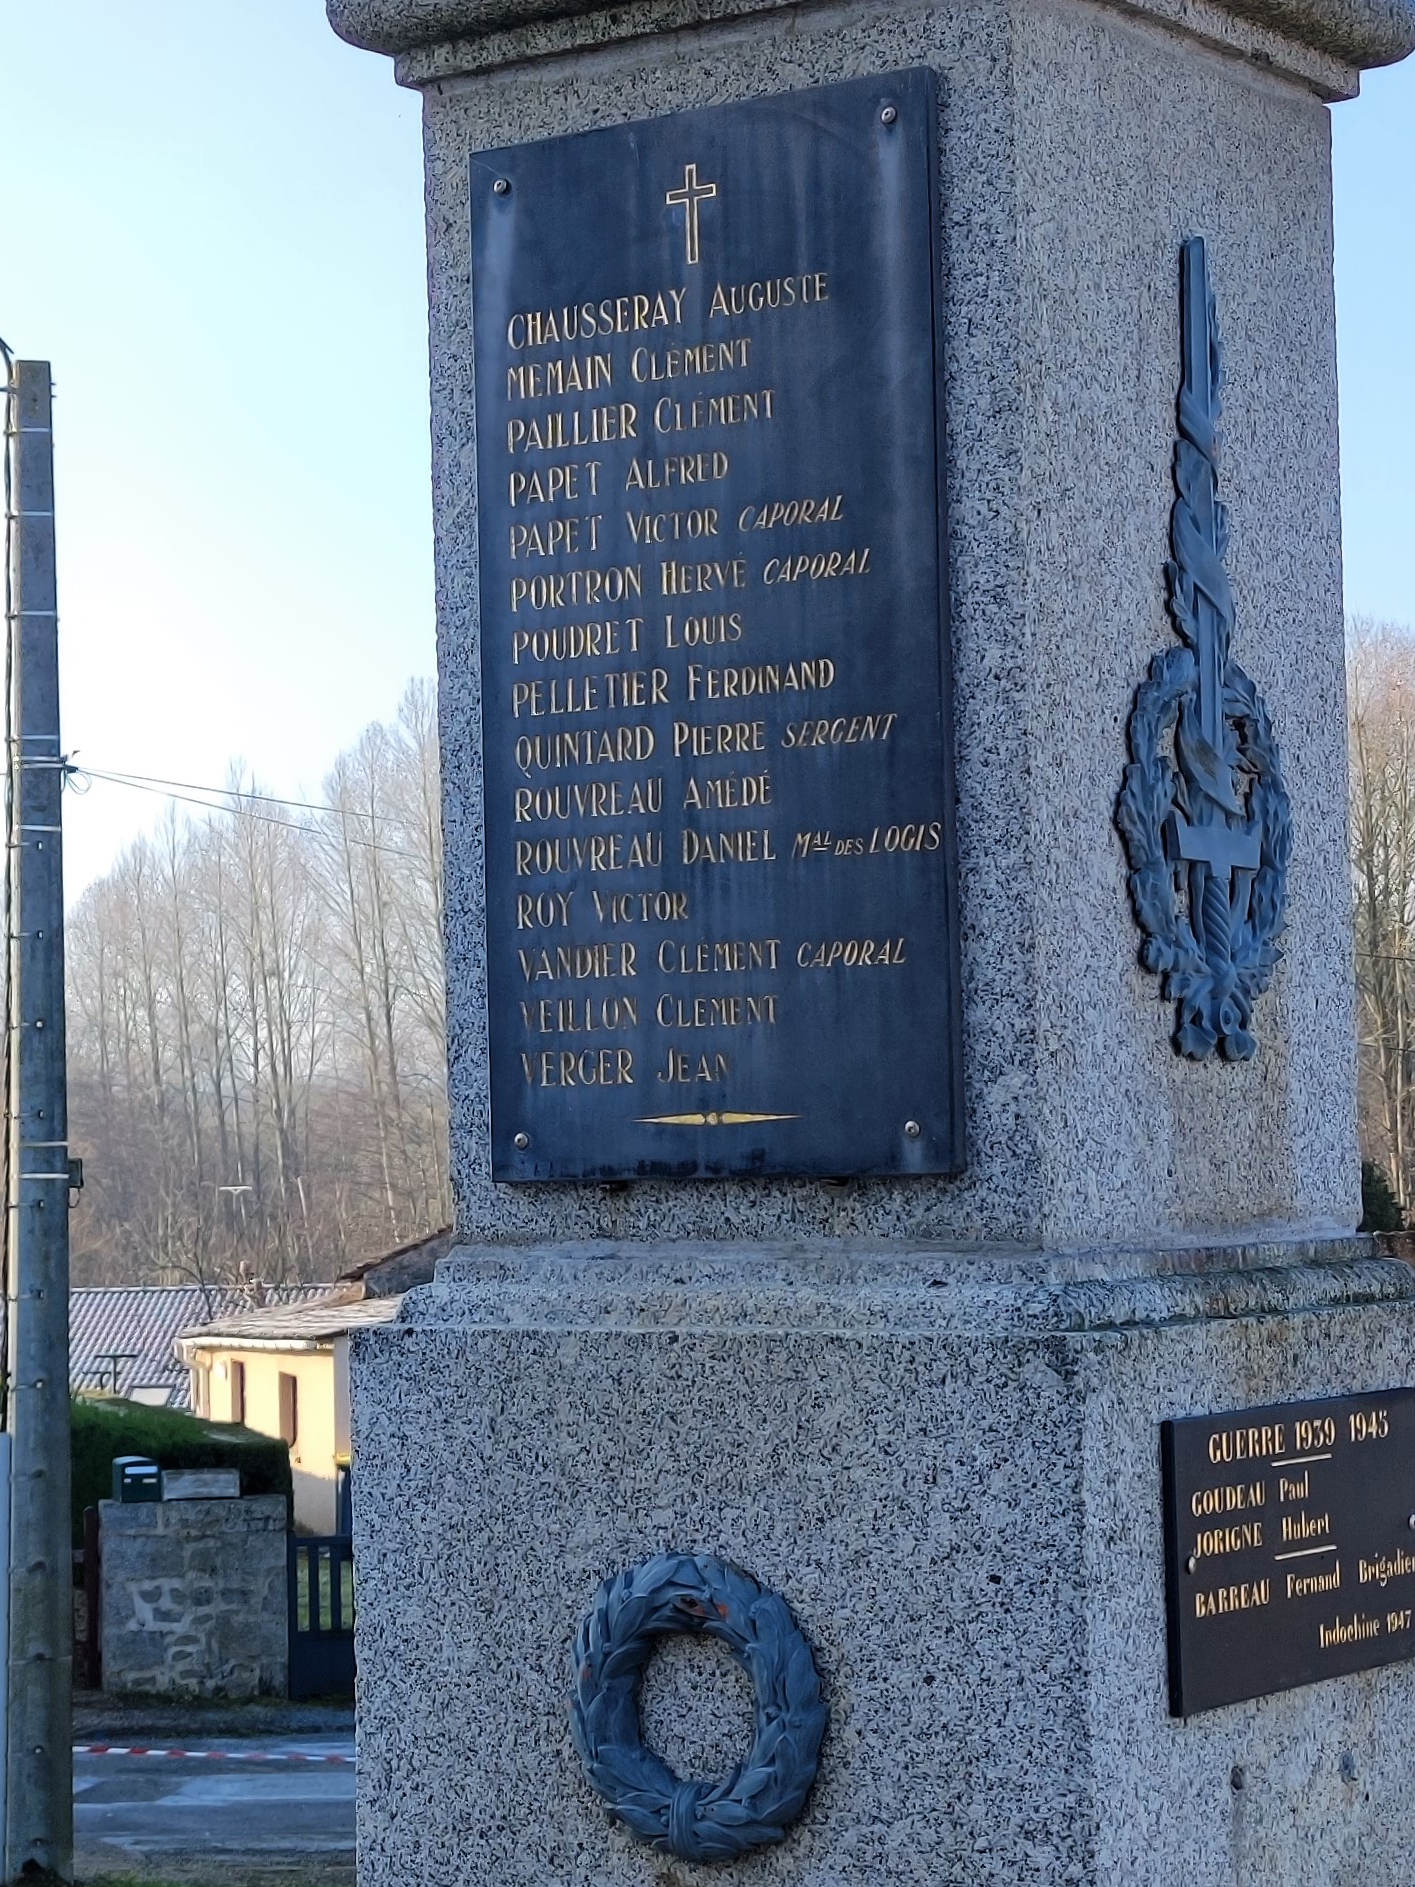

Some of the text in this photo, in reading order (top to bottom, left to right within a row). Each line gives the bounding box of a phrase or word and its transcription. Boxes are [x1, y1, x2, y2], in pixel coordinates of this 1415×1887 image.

[507, 273, 829, 350] CHAUSSERAY AUGUSTE
[507, 353, 612, 400] MEMAIN
[507, 403, 637, 454] PAILLIER
[509, 452, 728, 507] PAPET ALFRED
[509, 495, 843, 559] PAPET VICTOR CAPORAL
[511, 548, 871, 612] PORTRON HERVÉ CAPORAL
[512, 614, 742, 665] POUDRET LOUIS
[512, 658, 835, 718] PELLETIER FERDINAND
[515, 714, 897, 778] QUINTARD PIERRE SERGENT
[515, 770, 772, 822] ROUVREAU AMÉDÉ
[515, 831, 662, 876] ROUVREAU
[682, 829, 776, 865] DANIEL
[834, 838, 864, 856] DES
[869, 822, 941, 854] LOGIS
[516, 891, 688, 929] ROY VICTOR
[517, 943, 637, 982] VANDIER
[796, 937, 906, 967] CAPORAL
[519, 995, 640, 1032] VEILLON
[521, 1047, 729, 1087] VERGER JEAN
[1208, 1410, 1389, 1463] GUERRE 1939 1945
[1191, 1470, 1309, 1517] GOUDEAU Paul
[1193, 1510, 1330, 1559] JORIGNE Hubert
[1195, 1578, 1271, 1618] BARREAU
[1287, 1558, 1340, 1599] Fernand
[1319, 1610, 1412, 1648] Indochine 1947
